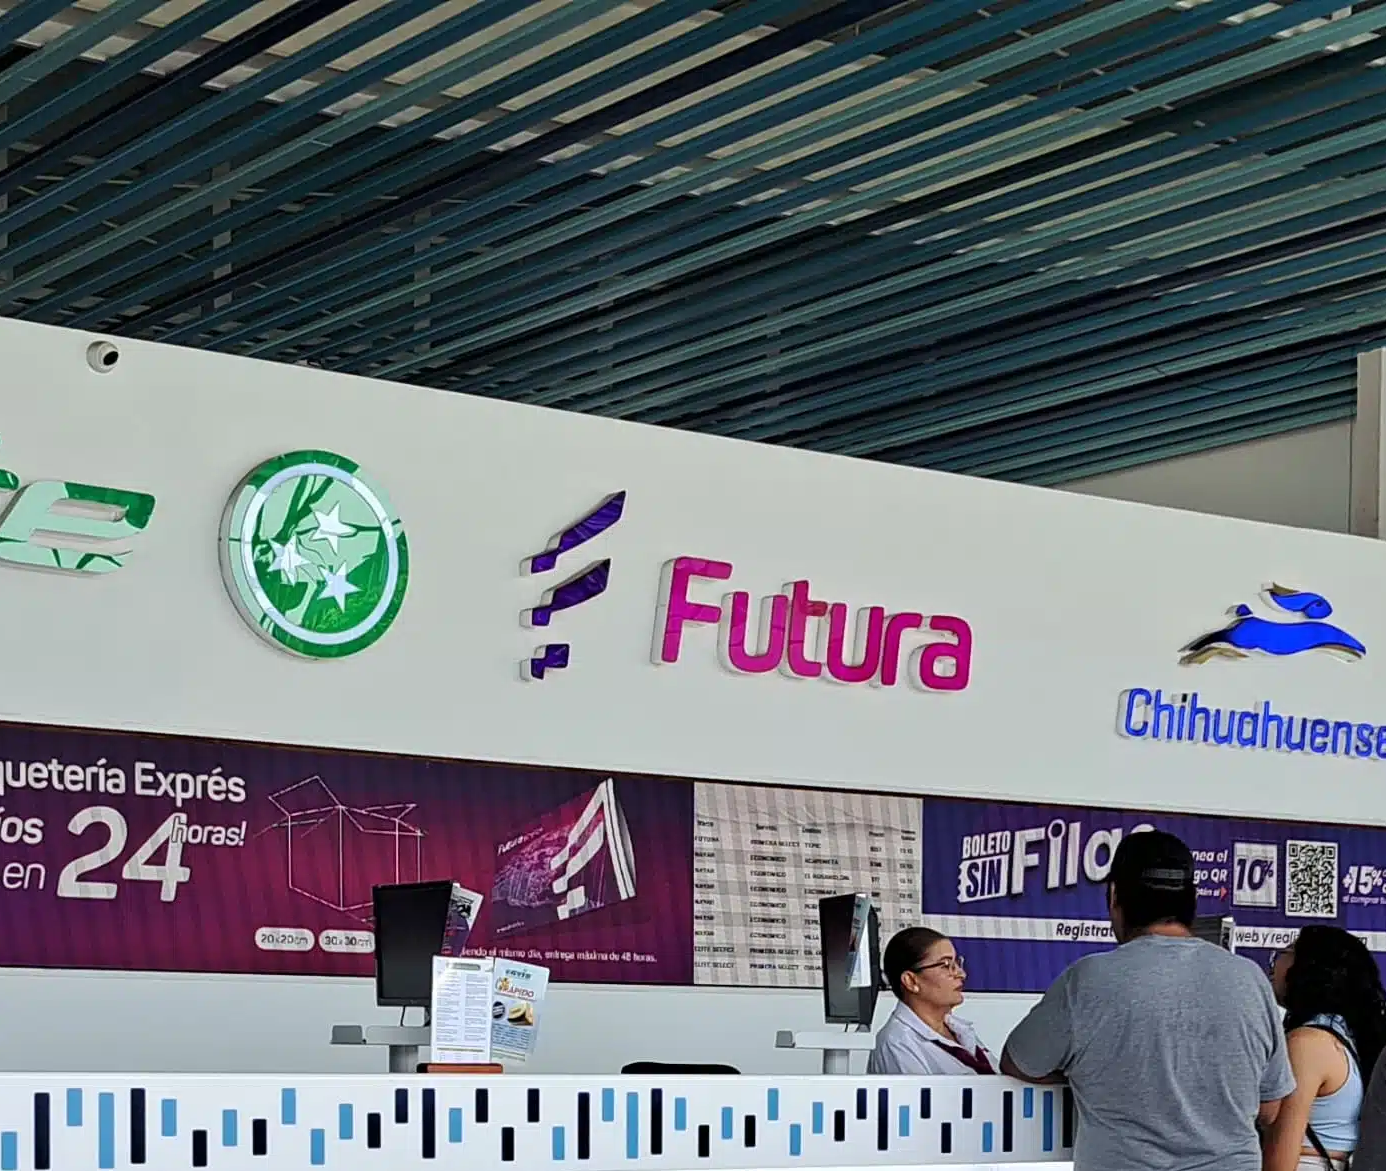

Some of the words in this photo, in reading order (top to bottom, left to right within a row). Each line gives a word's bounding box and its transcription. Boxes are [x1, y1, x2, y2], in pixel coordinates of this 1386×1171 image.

[655, 556, 973, 691] Futura
[135, 762, 246, 806] Exprés
[56, 805, 191, 902] 24
[170, 812, 247, 847] horas!
[963, 830, 1011, 858] BOLETO
[1011, 818, 1156, 896] Fila
[1192, 850, 1214, 862] nea
[2, 861, 45, 890] en
[966, 858, 1002, 899] SIN
[1210, 868, 1228, 884] QR
[1236, 858, 1274, 891] 10%
[1235, 931, 1259, 944] web
[1262, 933, 1270, 946] y
[1271, 932, 1300, 944] reali
